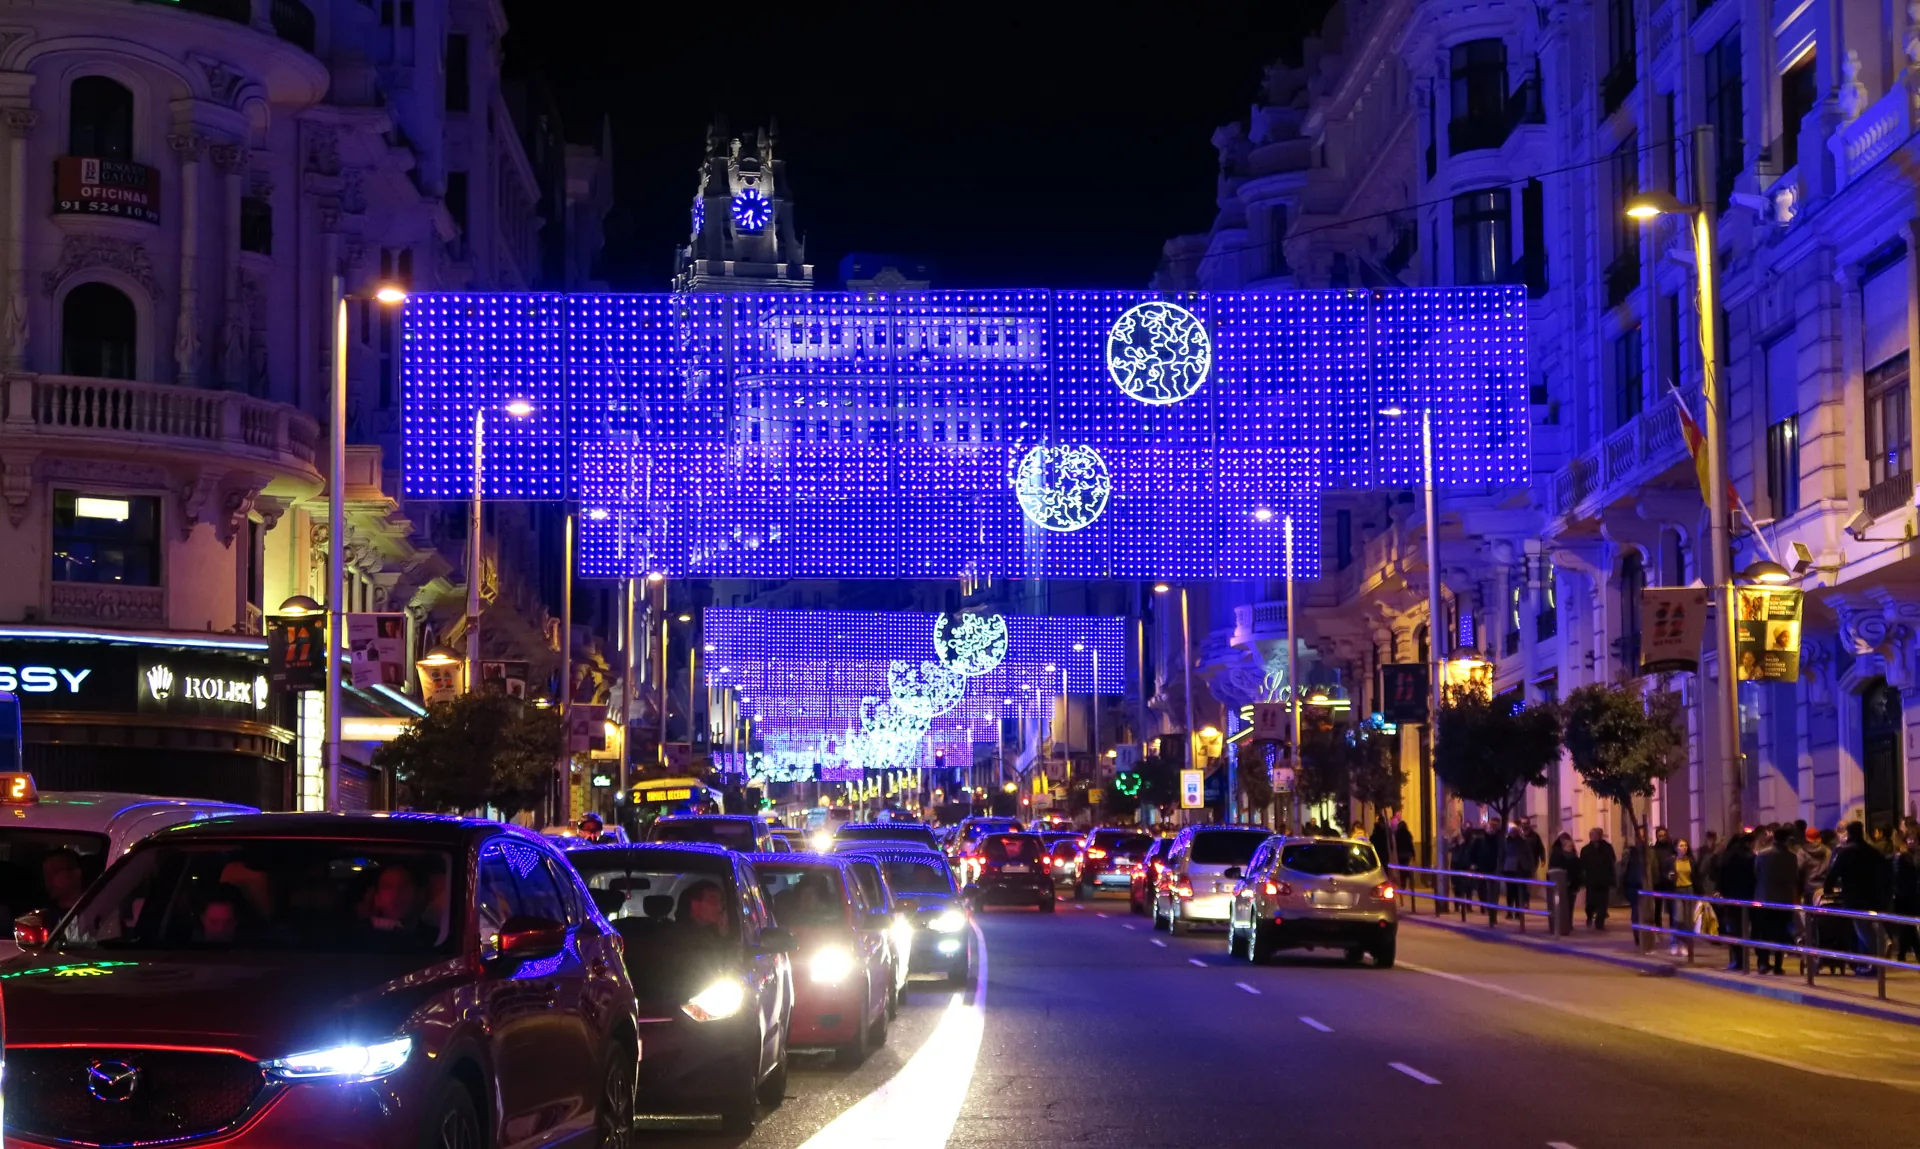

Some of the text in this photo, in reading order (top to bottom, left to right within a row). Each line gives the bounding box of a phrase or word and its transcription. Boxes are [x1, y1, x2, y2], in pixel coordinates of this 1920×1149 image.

[81, 187, 148, 205] OFICINAS
[61, 201, 81, 211] 91
[88, 202, 119, 213] 524
[127, 206, 142, 217] 10
[184, 676, 253, 705] ROLEX
[12, 777, 26, 798] 2
[633, 791, 642, 804] 2
